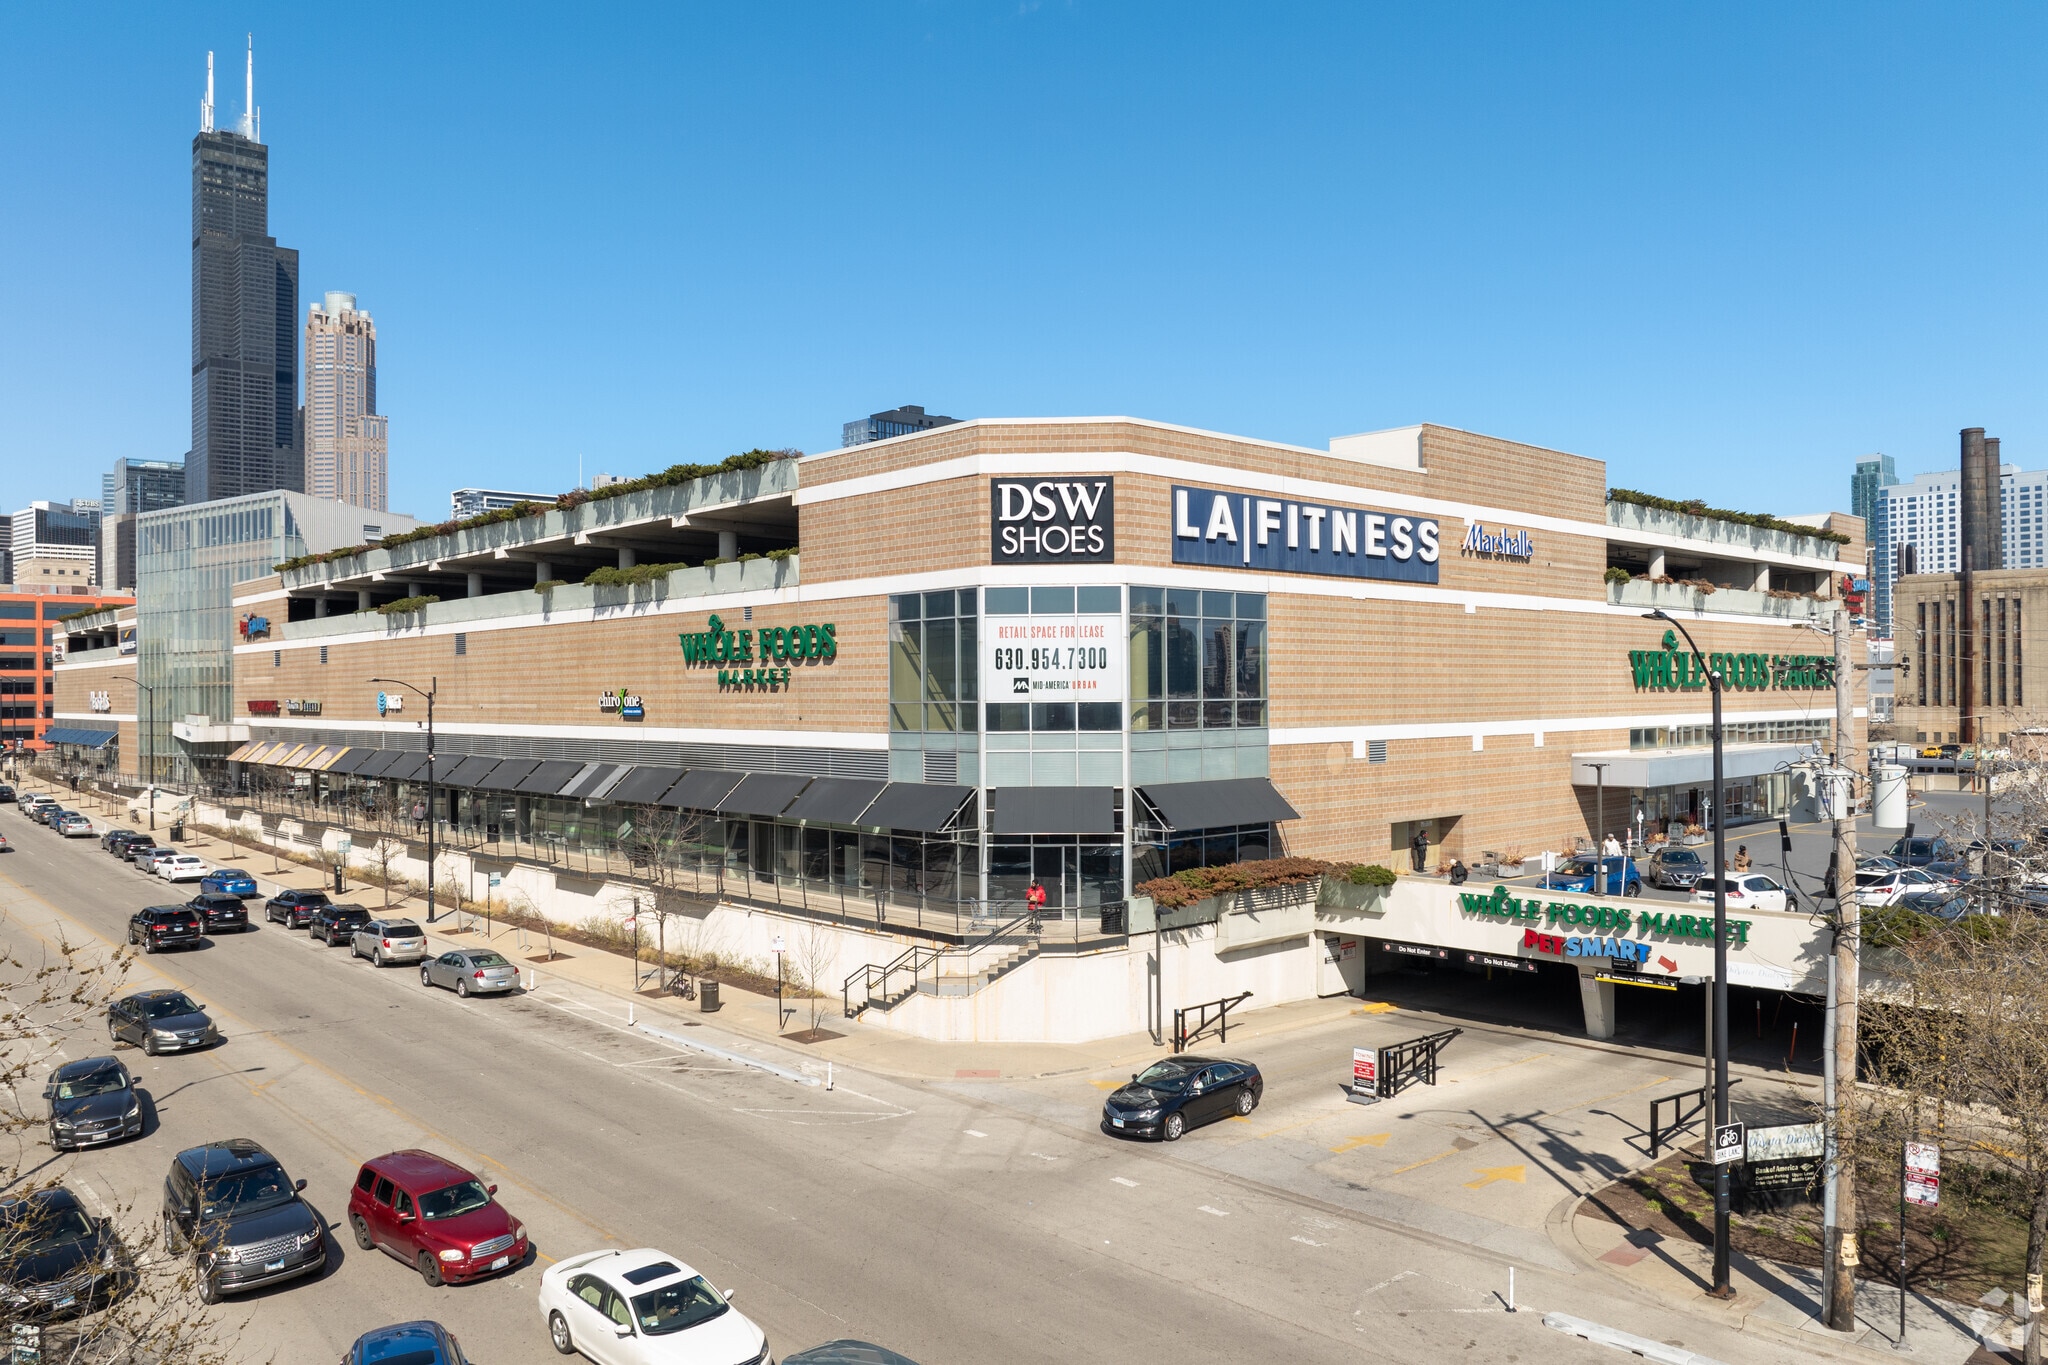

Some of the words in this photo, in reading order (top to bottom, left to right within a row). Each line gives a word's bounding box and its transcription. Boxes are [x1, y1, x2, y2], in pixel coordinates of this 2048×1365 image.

[998, 482, 1107, 521] DSW
[1176, 489, 1238, 542] LA
[1257, 500, 1439, 563] FITNESS
[1001, 525, 1105, 554] SHOES
[1463, 524, 1533, 557] Marshalls
[679, 630, 752, 661] WHOLE
[758, 623, 838, 659] FOODS
[999, 626, 1028, 638] RETAIL
[1031, 626, 1057, 638] SPACE
[1061, 626, 1075, 638] FOR
[1079, 625, 1105, 638] LEASE
[995, 647, 1107, 670] 630.954.7300
[1630, 650, 1706, 689] WHOLE
[1711, 652, 1770, 687] FOODS
[717, 668, 791, 690] MARKET
[1072, 680, 1097, 690] URBAN
[1459, 892, 1543, 921] WHOLE
[1550, 902, 1632, 931] FOODS
[1641, 911, 1753, 942] MARKET
[1417, 947, 1431, 956] Enter
[1524, 928, 1651, 963] PETSMART
[1484, 957, 1492, 965] Do
[1493, 959, 1503, 967] Not
[1504, 960, 1519, 969] Enter
[1717, 1150, 1727, 1160] BIKE
[1756, 1166, 1770, 1174] Bank
[1776, 1164, 1799, 1172] America
